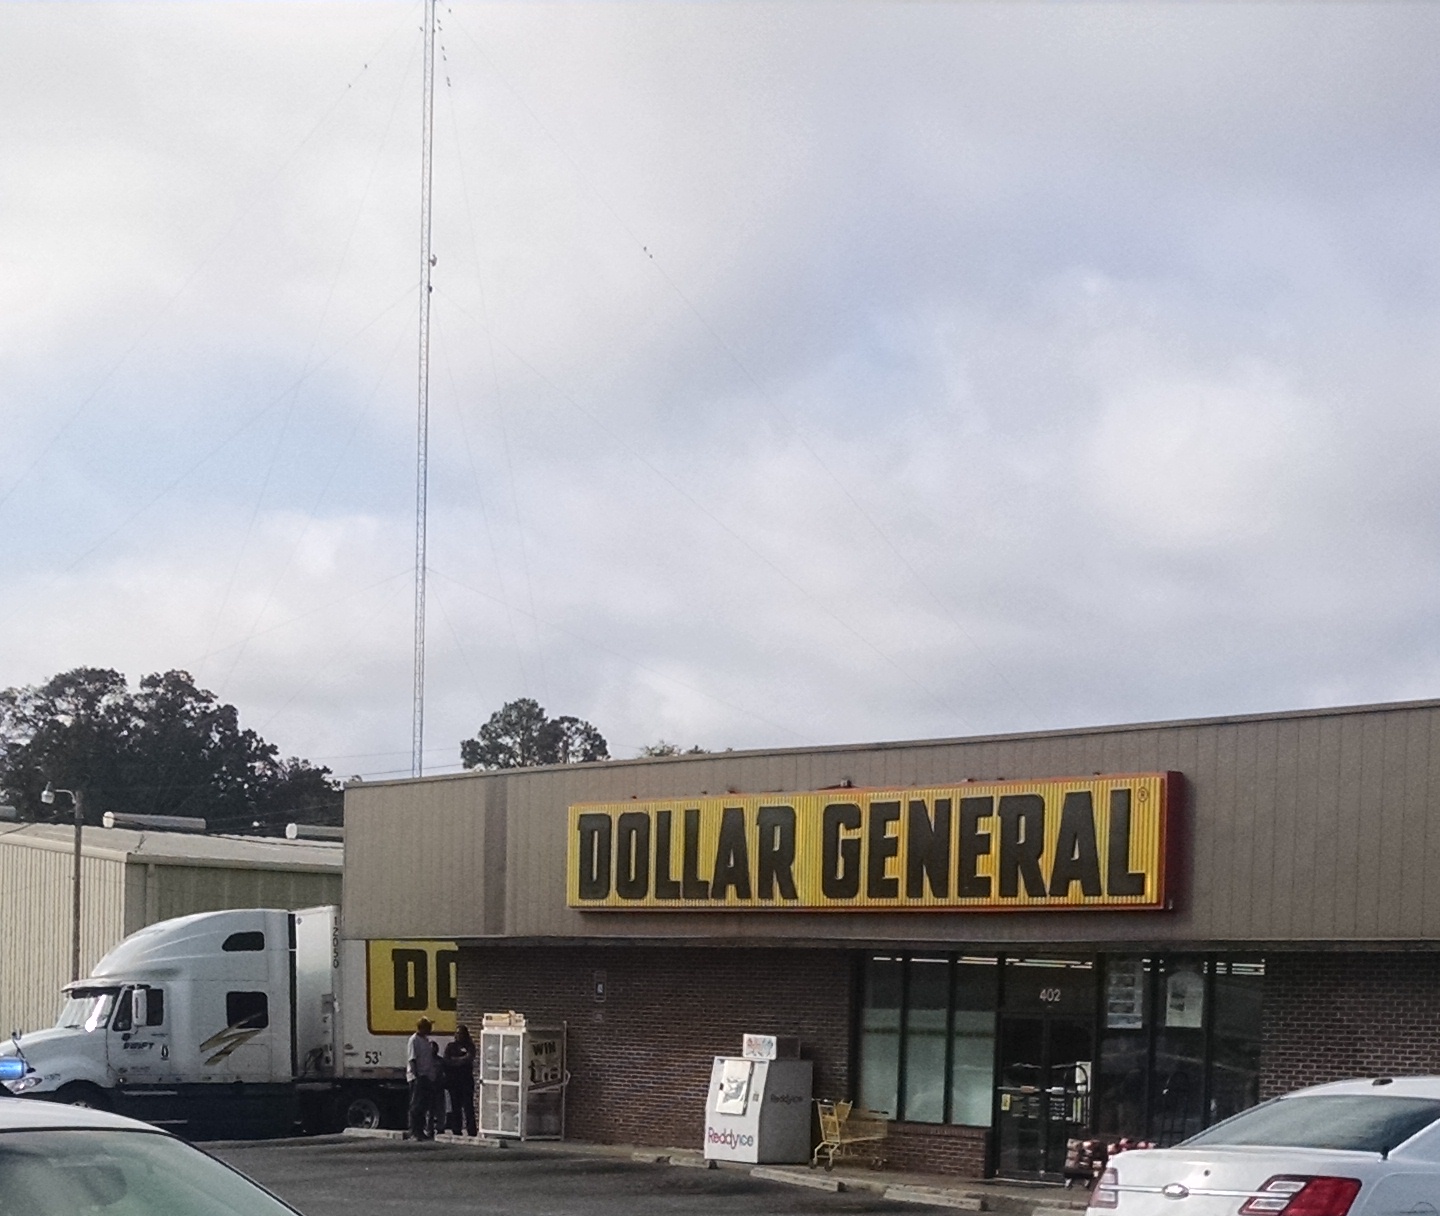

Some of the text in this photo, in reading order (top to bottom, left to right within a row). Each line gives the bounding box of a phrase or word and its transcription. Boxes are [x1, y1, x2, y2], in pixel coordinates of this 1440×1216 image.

[577, 788, 1147, 901] DOLLAR GENERAL
[1039, 988, 1061, 1002] 402
